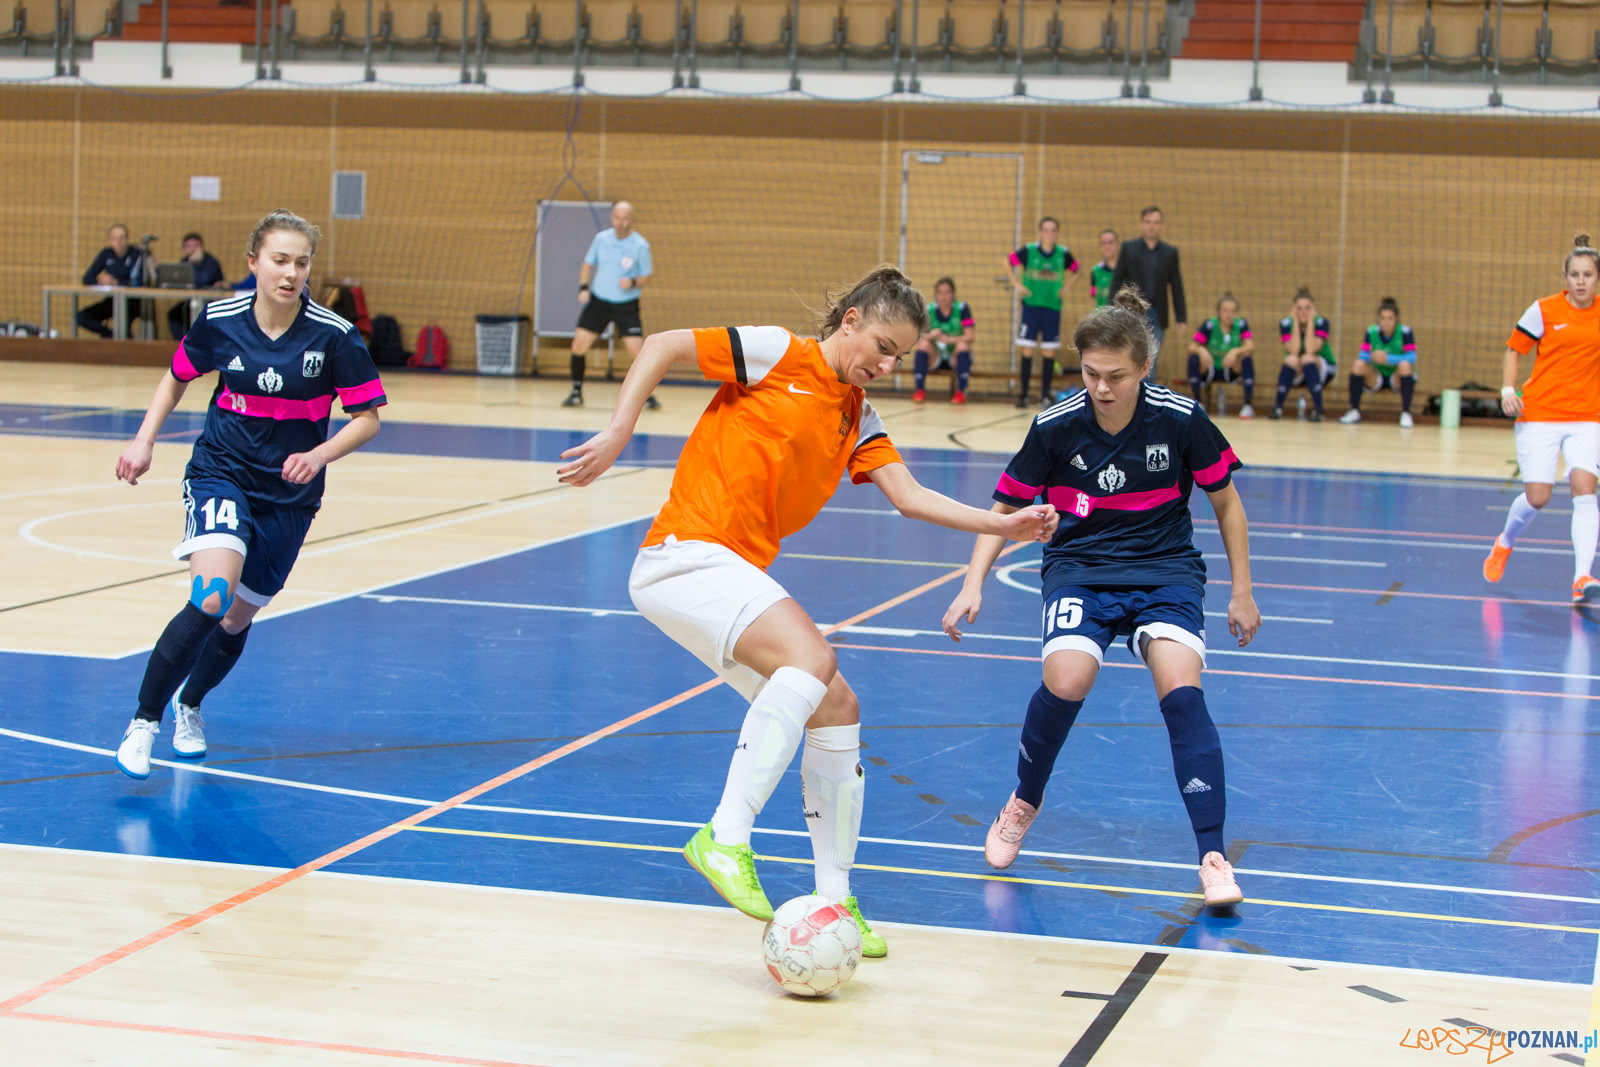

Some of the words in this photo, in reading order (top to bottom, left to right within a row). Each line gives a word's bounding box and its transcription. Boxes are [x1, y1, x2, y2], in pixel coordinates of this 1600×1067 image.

[228, 393, 247, 413] 14
[200, 497, 240, 531] 14
[1075, 492, 1089, 517] 15
[1046, 597, 1084, 636] 15
